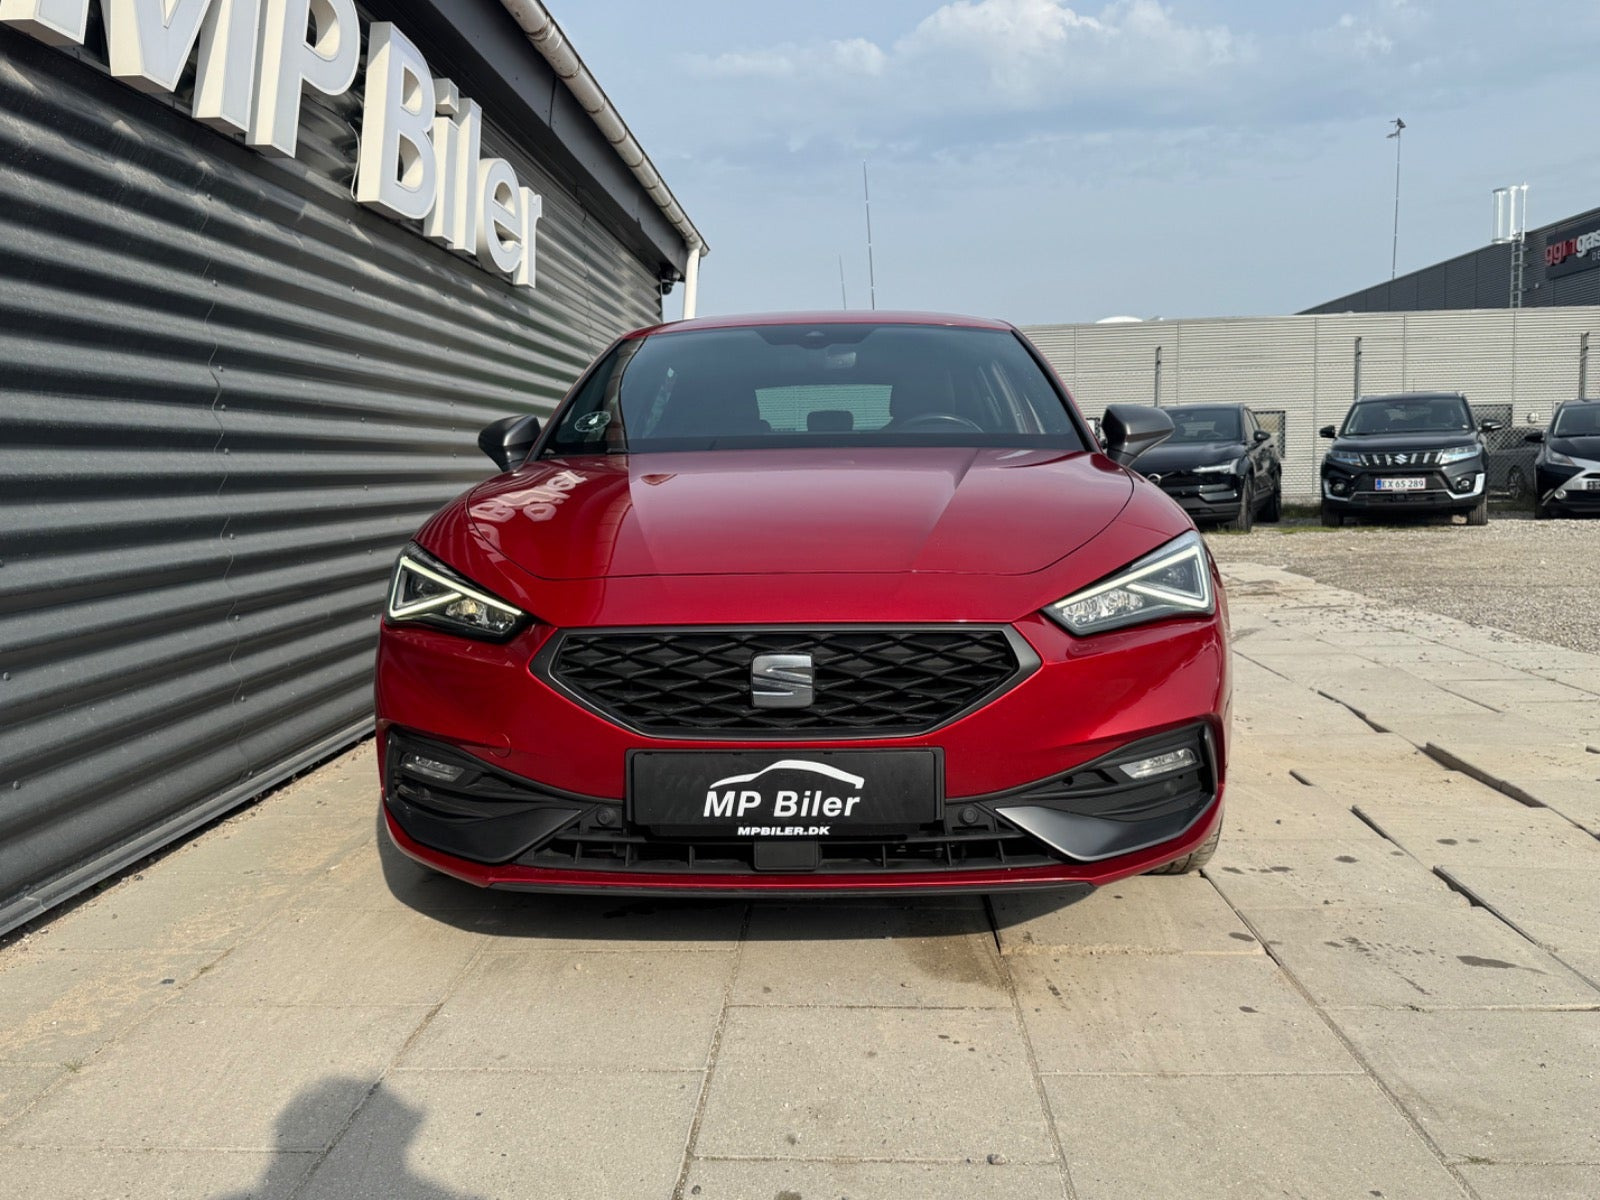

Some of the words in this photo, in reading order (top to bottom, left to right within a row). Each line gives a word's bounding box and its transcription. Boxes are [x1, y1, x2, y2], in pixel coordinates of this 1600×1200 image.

[357, 21, 542, 288] Biler
[703, 790, 762, 817] MP
[773, 790, 861, 817] Biler
[737, 826, 831, 836] MPBILER.DK
